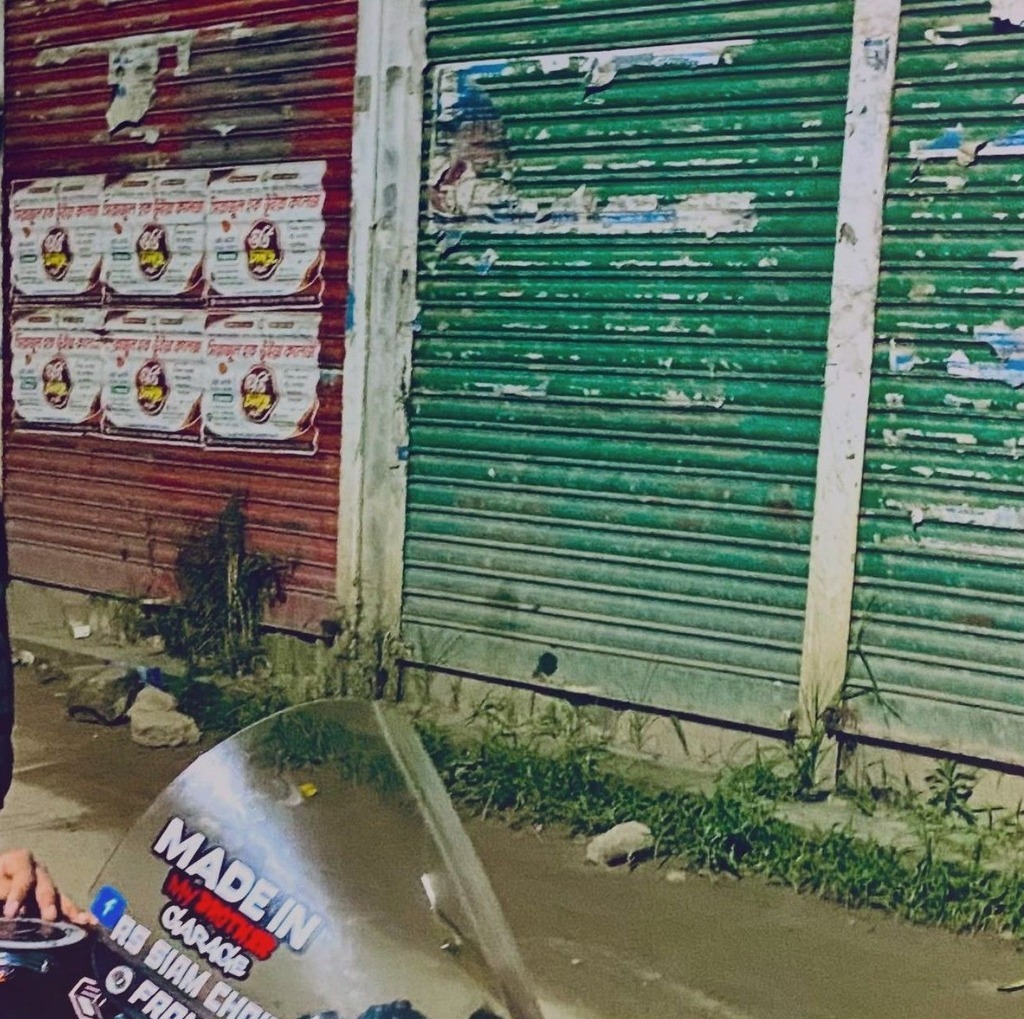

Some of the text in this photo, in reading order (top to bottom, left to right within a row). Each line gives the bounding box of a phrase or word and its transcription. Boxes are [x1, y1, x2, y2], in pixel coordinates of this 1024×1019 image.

[153, 817, 322, 950] MADE IN
[144, 939, 211, 998] SIAM
[160, 904, 251, 977] GARAGE
